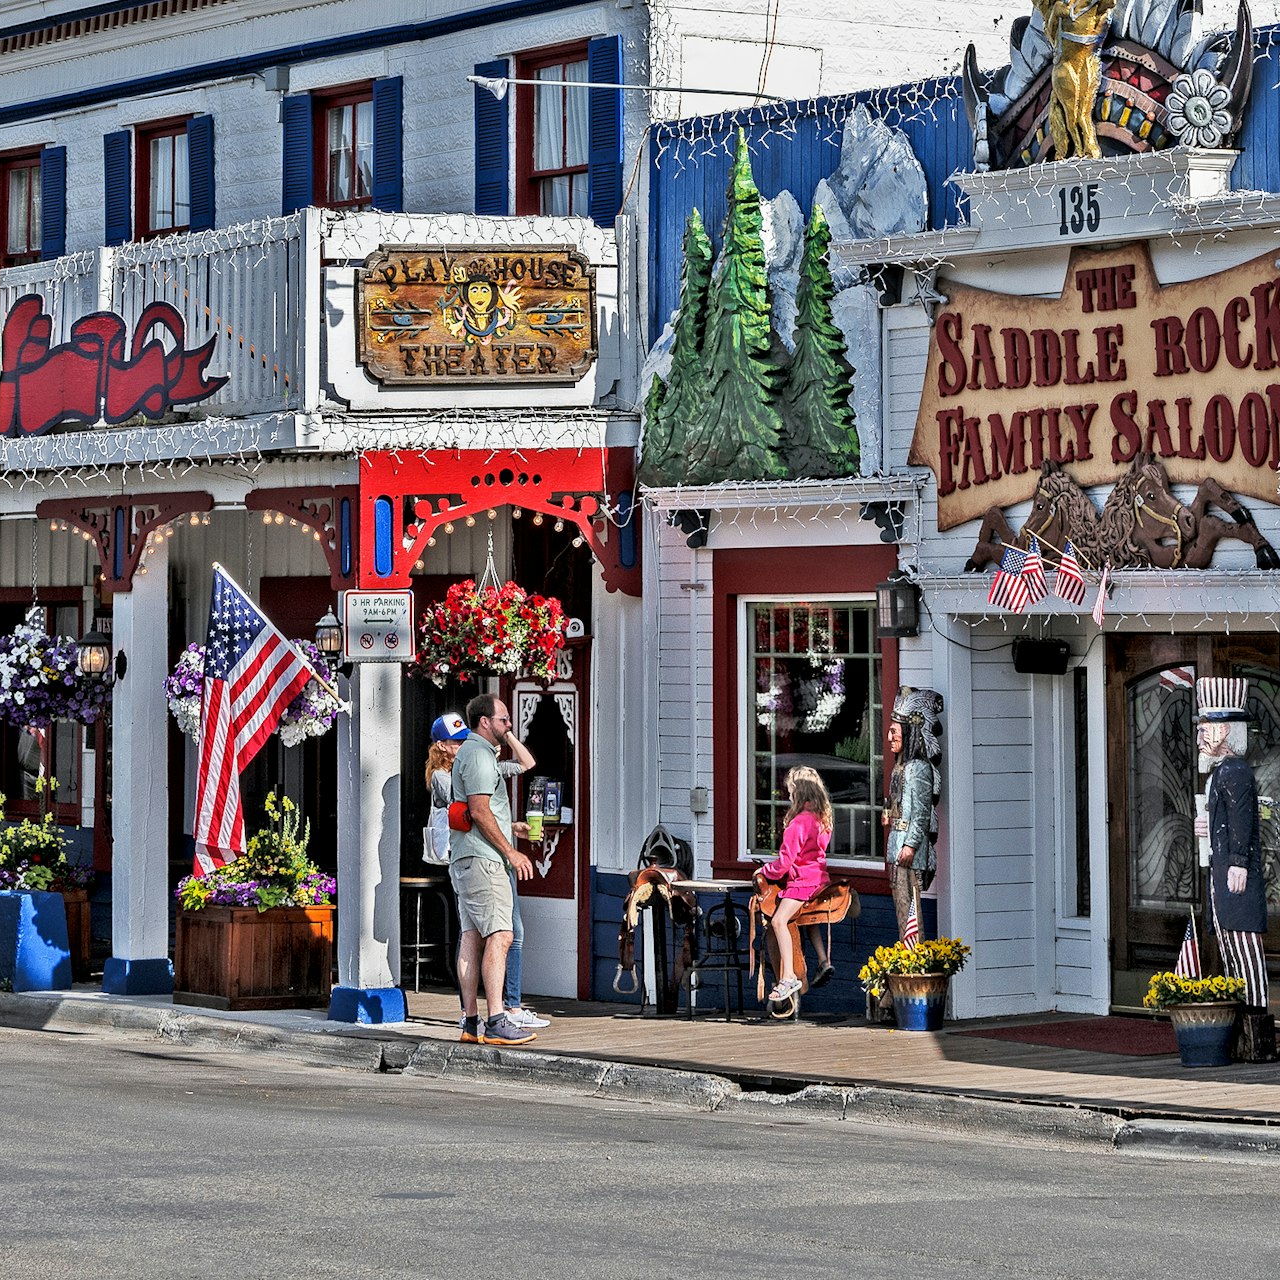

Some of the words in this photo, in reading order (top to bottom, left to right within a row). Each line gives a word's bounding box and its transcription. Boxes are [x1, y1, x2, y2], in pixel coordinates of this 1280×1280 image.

[1058, 184, 1100, 236] 135
[379, 256, 456, 294] PLAY
[493, 256, 577, 288] HOUSE
[1075, 264, 1137, 314] THE
[400, 343, 558, 376] THEATER
[935, 312, 1126, 398] SADDLE
[935, 403, 1099, 498] FAMILY
[352, 598, 358, 606] 3
[360, 598, 371, 606] HR
[373, 598, 406, 606] PARKING
